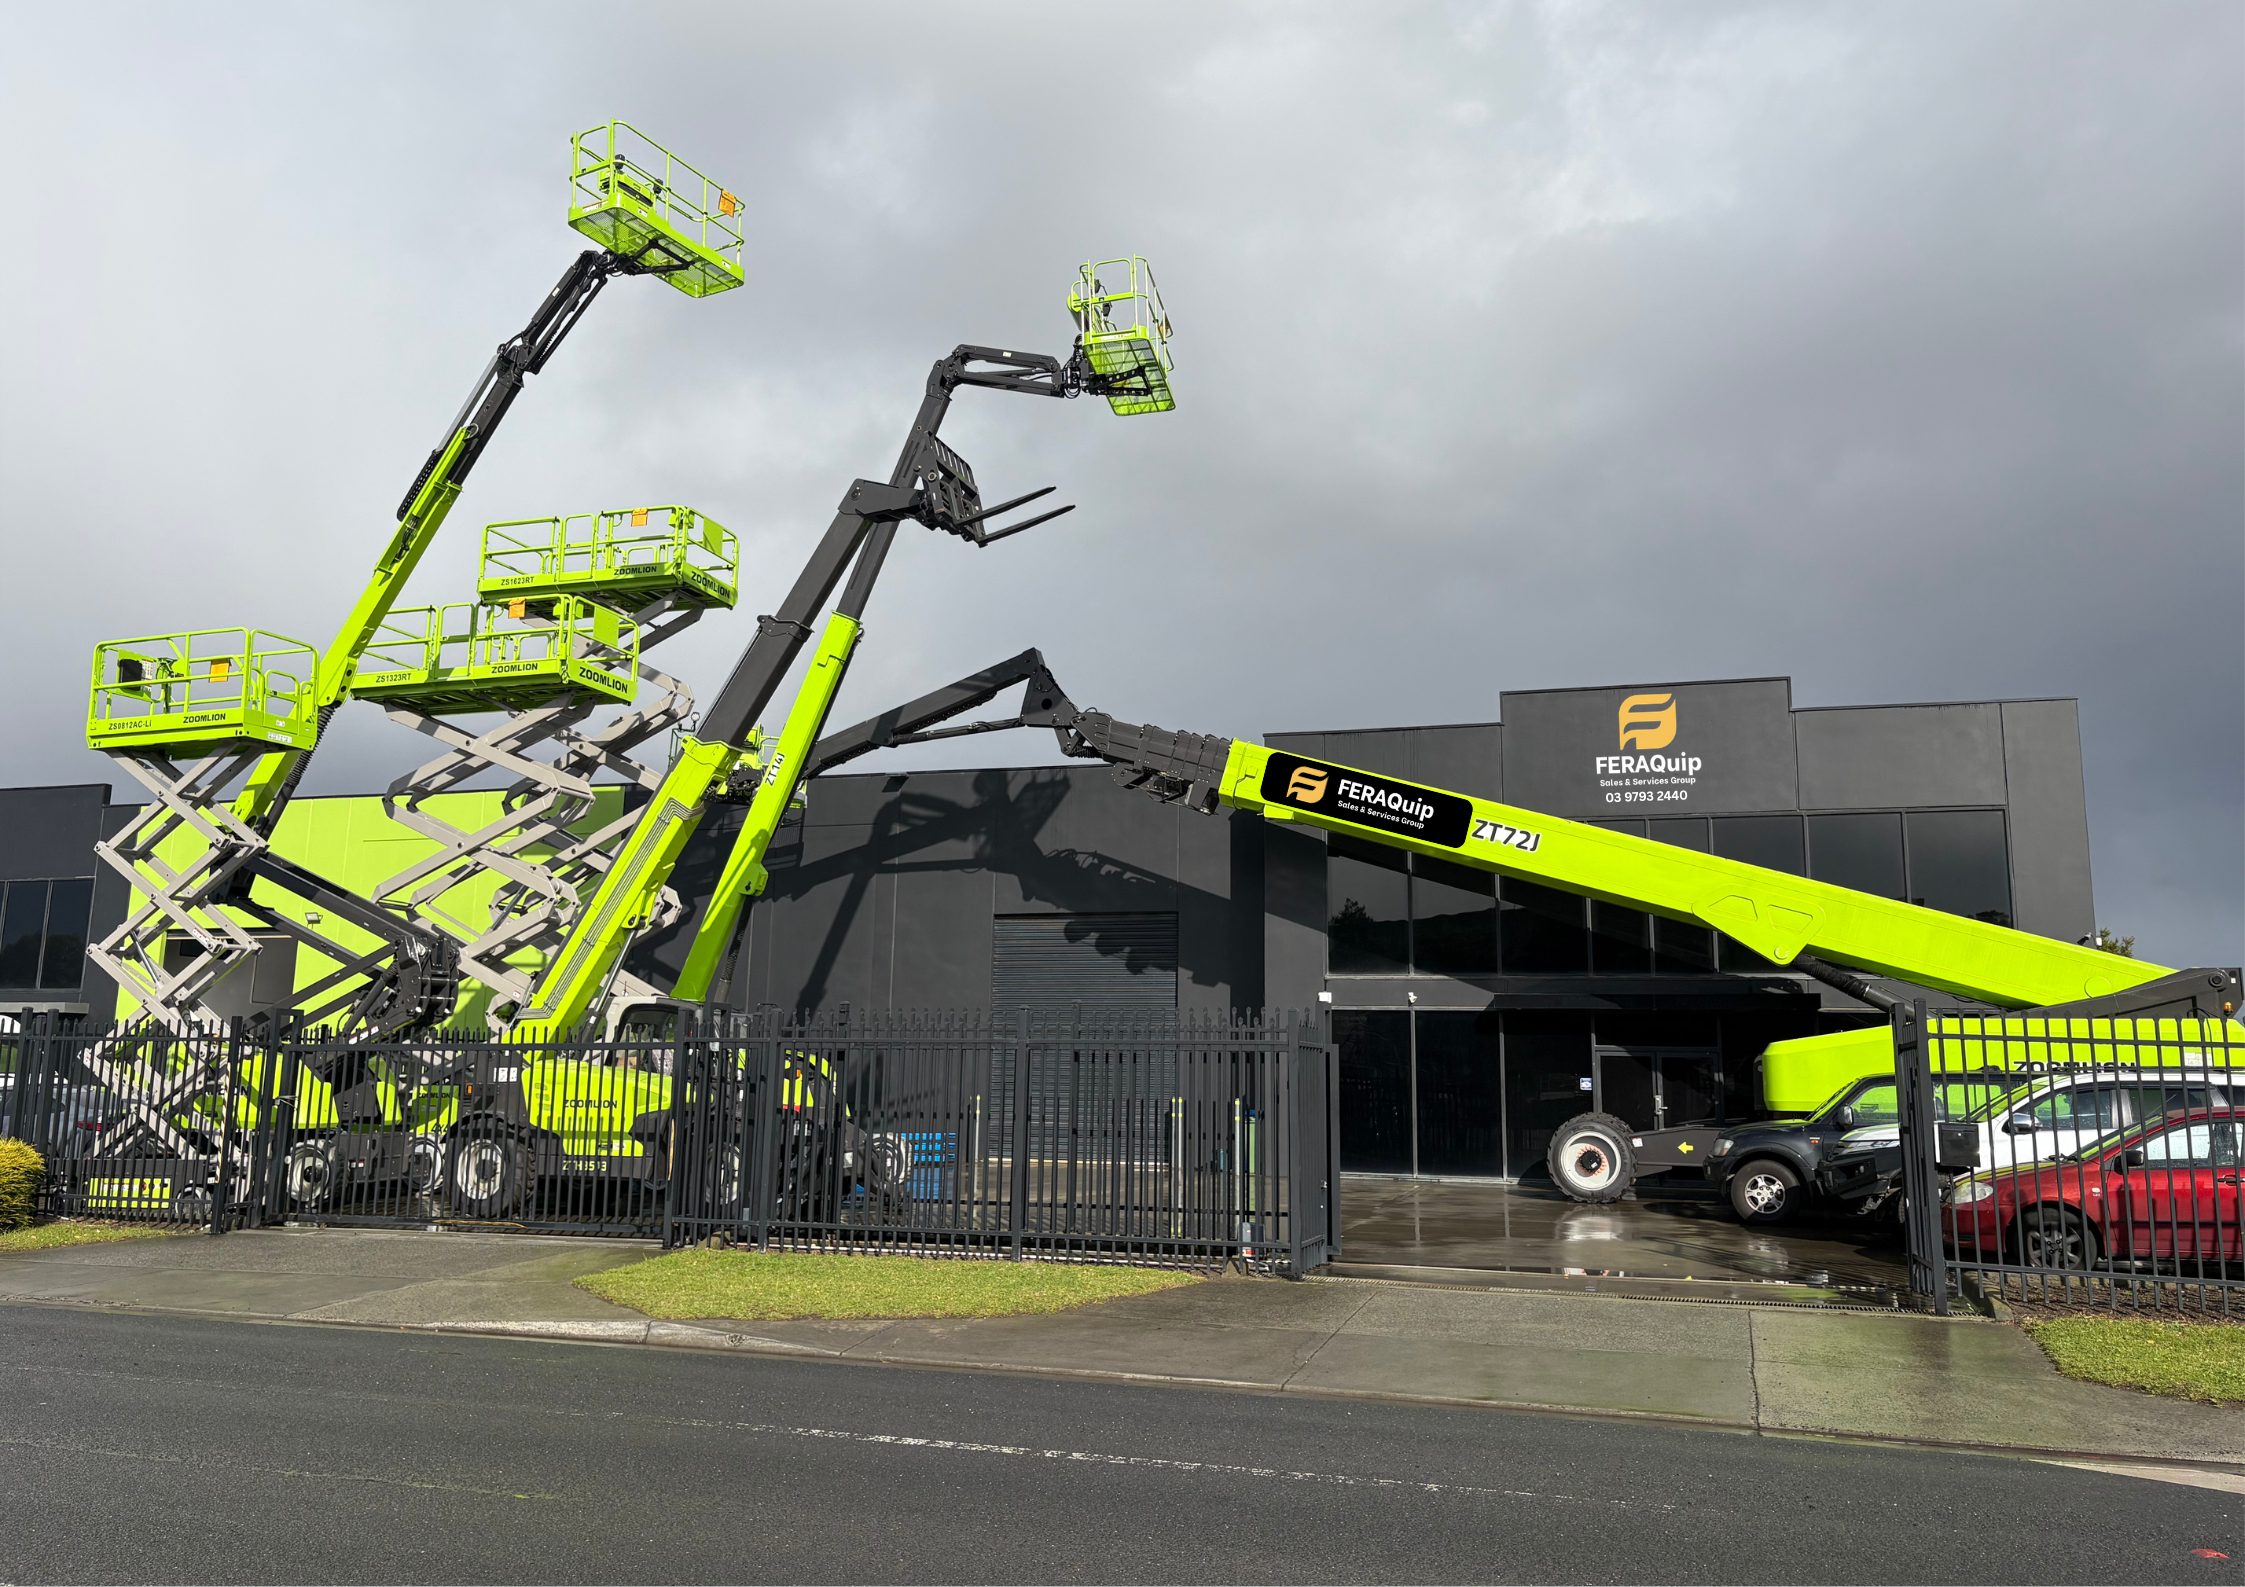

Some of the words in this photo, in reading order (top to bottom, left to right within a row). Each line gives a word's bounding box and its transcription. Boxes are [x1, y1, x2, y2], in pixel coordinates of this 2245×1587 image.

[613, 565, 657, 576] ZOOMLION
[500, 576, 535, 586] ZS1623RT
[691, 571, 730, 599] ZOOMLION
[491, 663, 538, 674] ZOOMLION
[375, 673, 412, 683] ZS1323RT
[578, 666, 628, 694] ZOOMLION
[183, 713, 226, 724] ZOOMLION
[765, 752, 785, 787] ZT14J
[1596, 752, 1702, 775] FERAQuip
[1600, 779, 1623, 787] Sales
[1624, 778, 1631, 786] &
[1632, 777, 1669, 786] Services
[1670, 777, 1696, 785] Group
[1337, 779, 1434, 821] FERAQuip
[1605, 792, 1622, 803] 03
[1624, 791, 1654, 802] 9793
[1656, 790, 1688, 801] 2440
[1337, 800, 1359, 812] Sales
[1367, 808, 1399, 822] Services
[1401, 817, 1425, 830] Group
[1471, 818, 1541, 852] ZT72J
